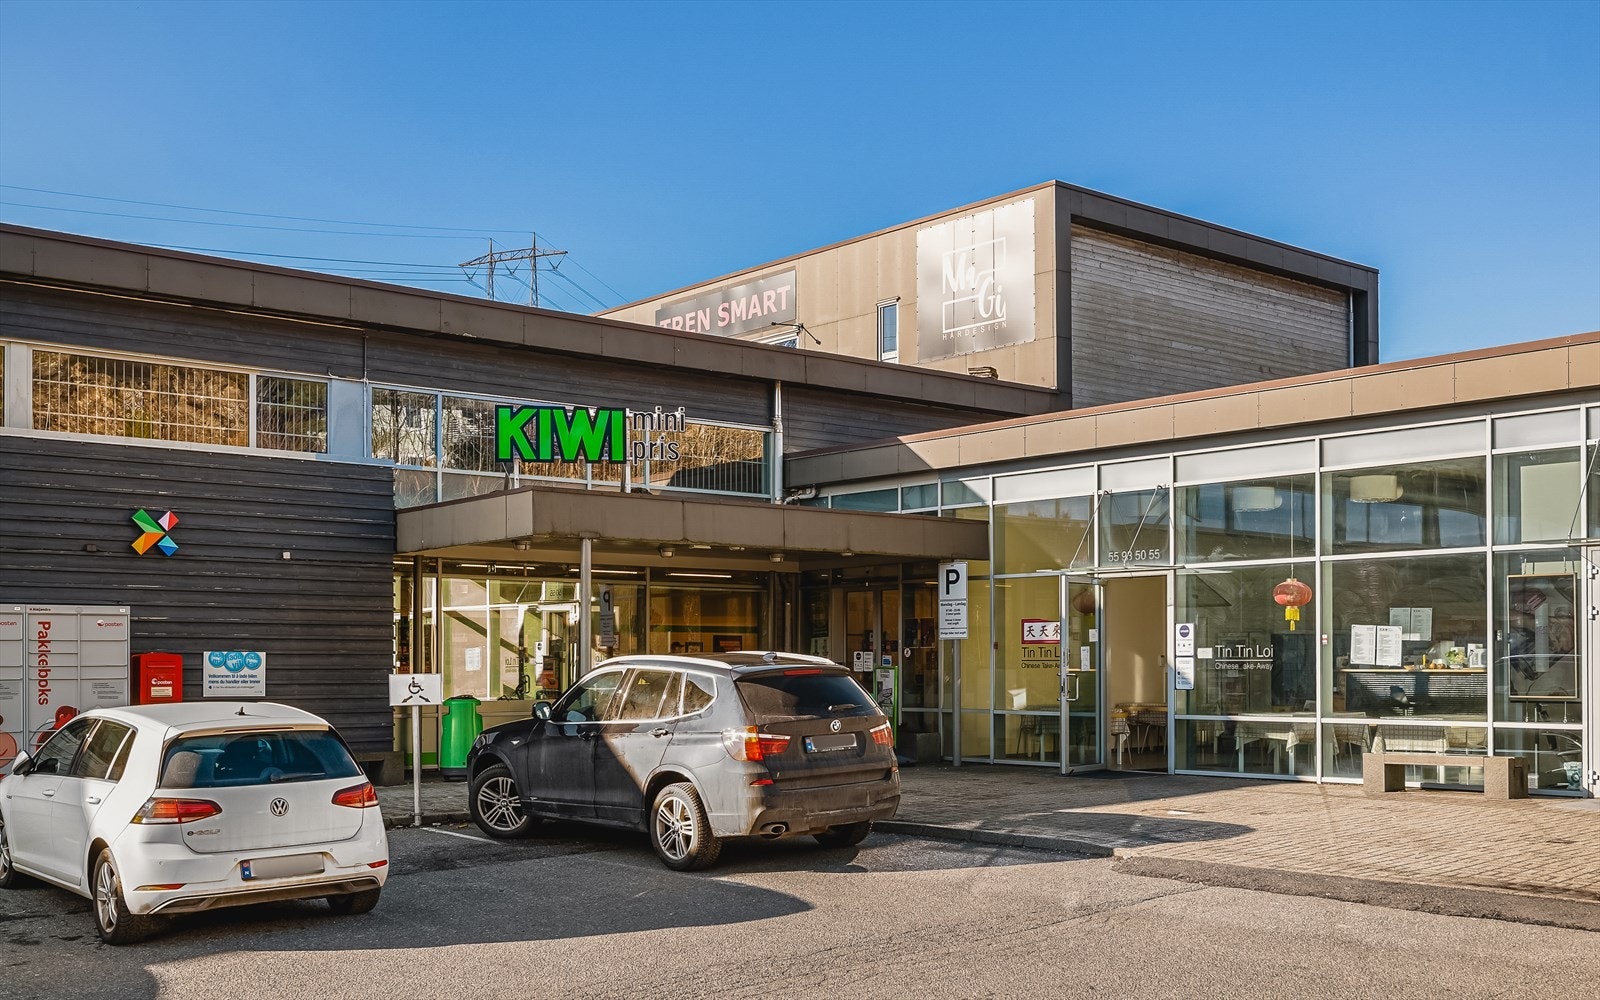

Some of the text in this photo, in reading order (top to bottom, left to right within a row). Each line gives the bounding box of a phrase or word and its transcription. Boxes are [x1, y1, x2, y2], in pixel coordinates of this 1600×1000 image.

[717, 285, 791, 327] SMART
[632, 405, 686, 433] mini
[495, 405, 627, 464] KIWI
[632, 434, 680, 466] pris
[1108, 549, 1160, 562] 55 93 50 55
[946, 569, 960, 595] P
[38, 621, 51, 706] Pakkeboks
[1021, 647, 1035, 658] Tin
[1038, 647, 1051, 658] Tin
[1215, 645, 1232, 657] Tin
[1236, 645, 1253, 657] Tin
[1256, 645, 1273, 657] Loi
[1215, 662, 1273, 671] Chinese ake-Away
